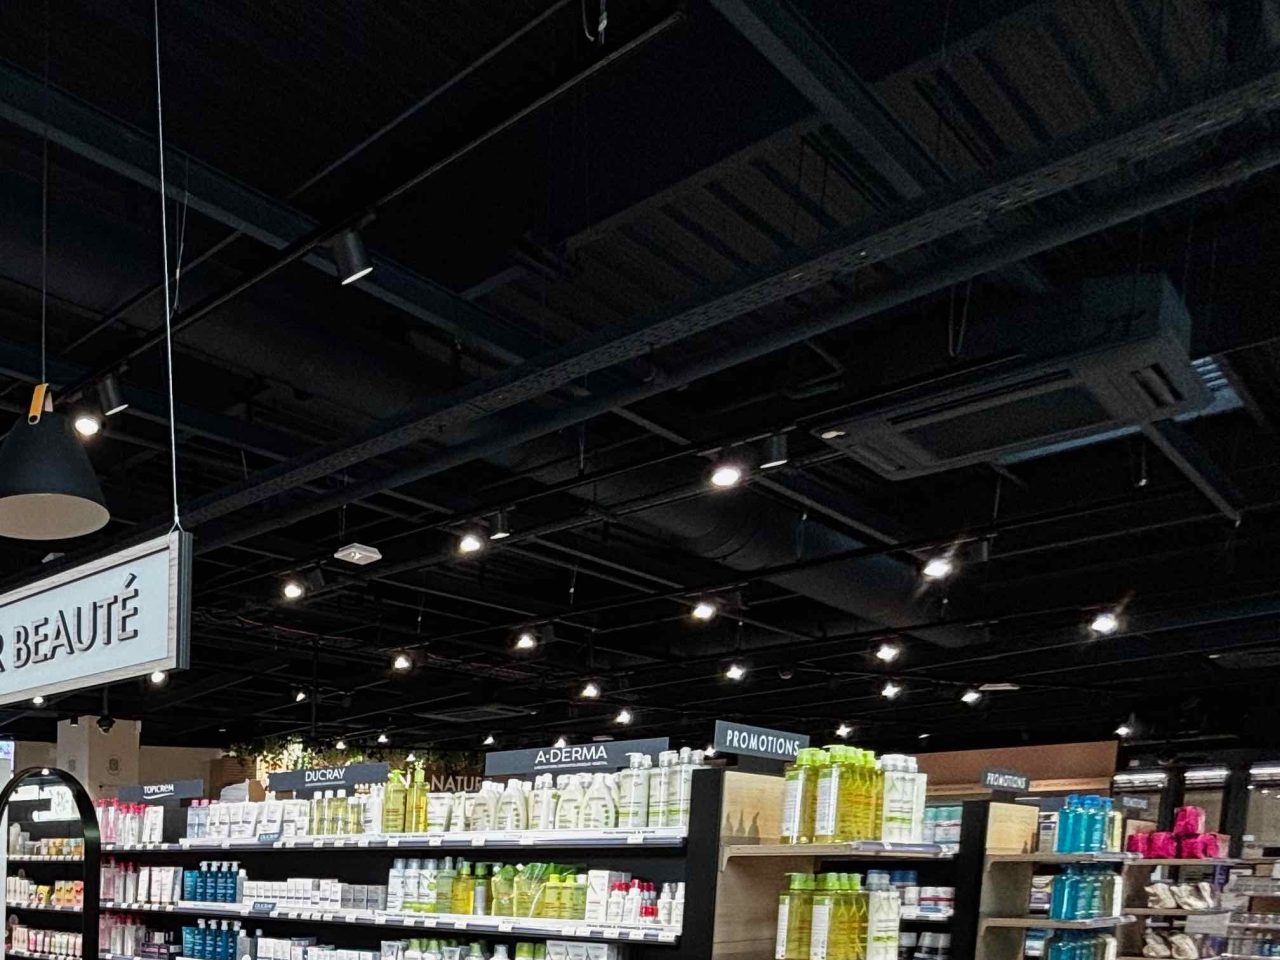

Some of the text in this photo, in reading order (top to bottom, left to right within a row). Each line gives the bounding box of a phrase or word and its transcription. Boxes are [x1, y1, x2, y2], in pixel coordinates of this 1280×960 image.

[13, 572, 140, 669] BEAUTÉ
[726, 729, 799, 756] PROMOTIONS
[305, 768, 346, 782] DUCRAY
[431, 774, 493, 791] NATUR
